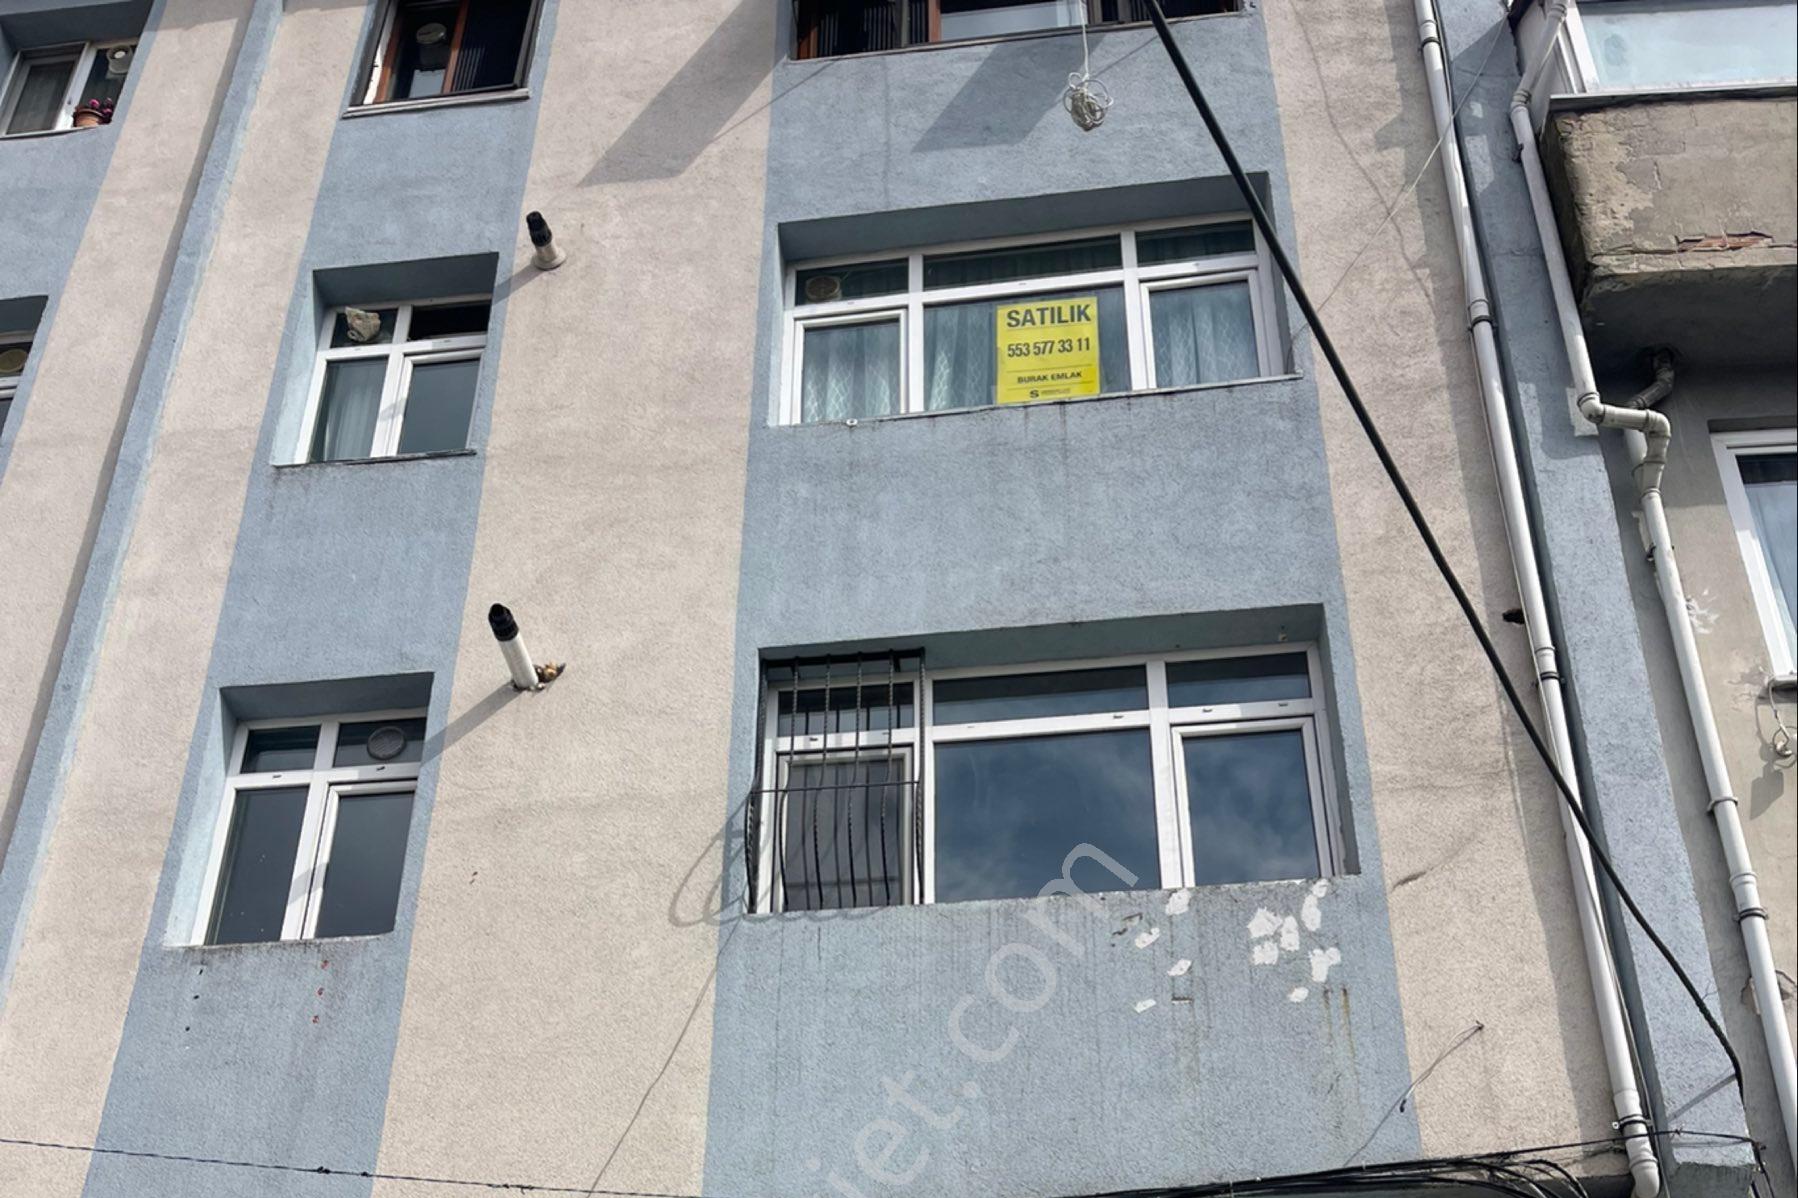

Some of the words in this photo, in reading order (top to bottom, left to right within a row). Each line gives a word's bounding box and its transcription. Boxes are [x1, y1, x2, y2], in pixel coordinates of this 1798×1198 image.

[1006, 304, 1092, 328] SATILIK
[1007, 342, 1031, 358] 553
[1033, 340, 1055, 356] 577
[1058, 338, 1073, 353] 33
[1077, 337, 1090, 352] 11
[1017, 375, 1049, 384] BURAK
[1051, 371, 1082, 381] EMLAK
